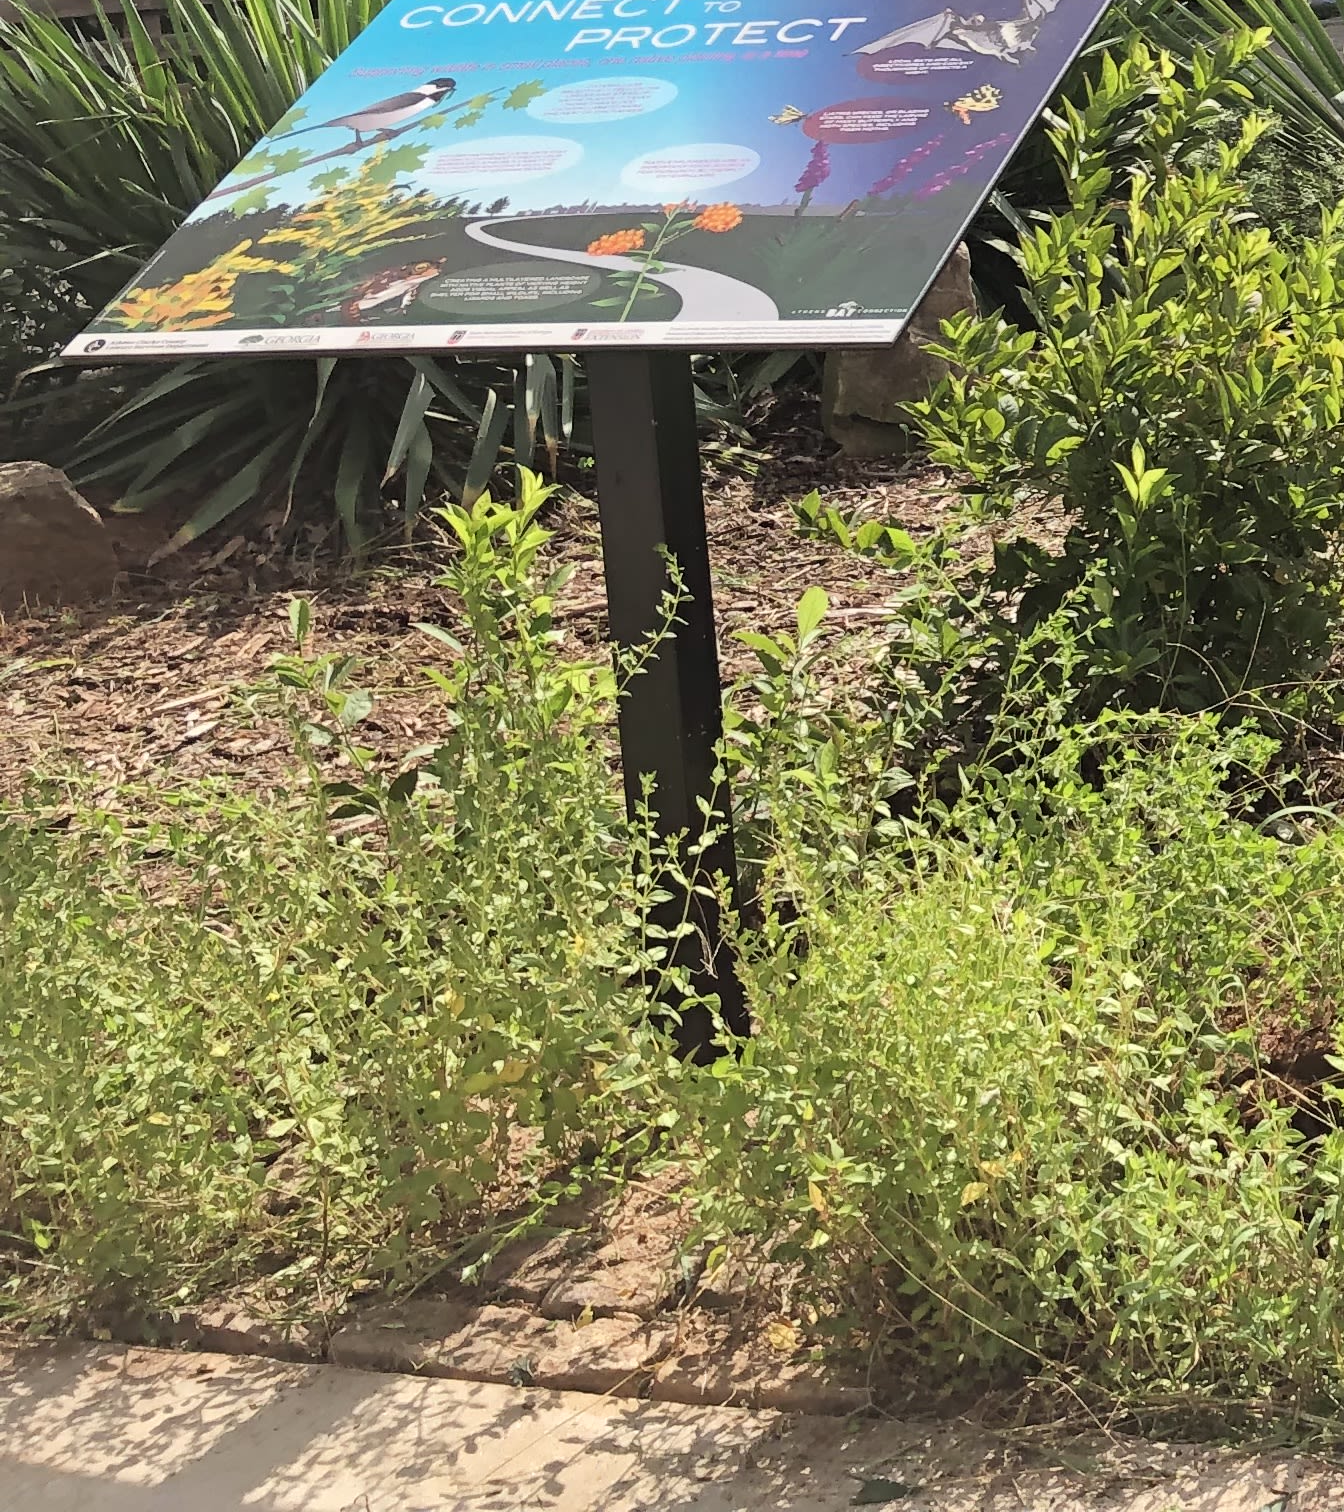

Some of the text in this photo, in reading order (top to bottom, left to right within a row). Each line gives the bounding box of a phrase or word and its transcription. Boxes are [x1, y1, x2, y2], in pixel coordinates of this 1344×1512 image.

[704, 0, 742, 13] TO
[563, 16, 868, 53] PROTECT
[825, 308, 858, 317] BAT
